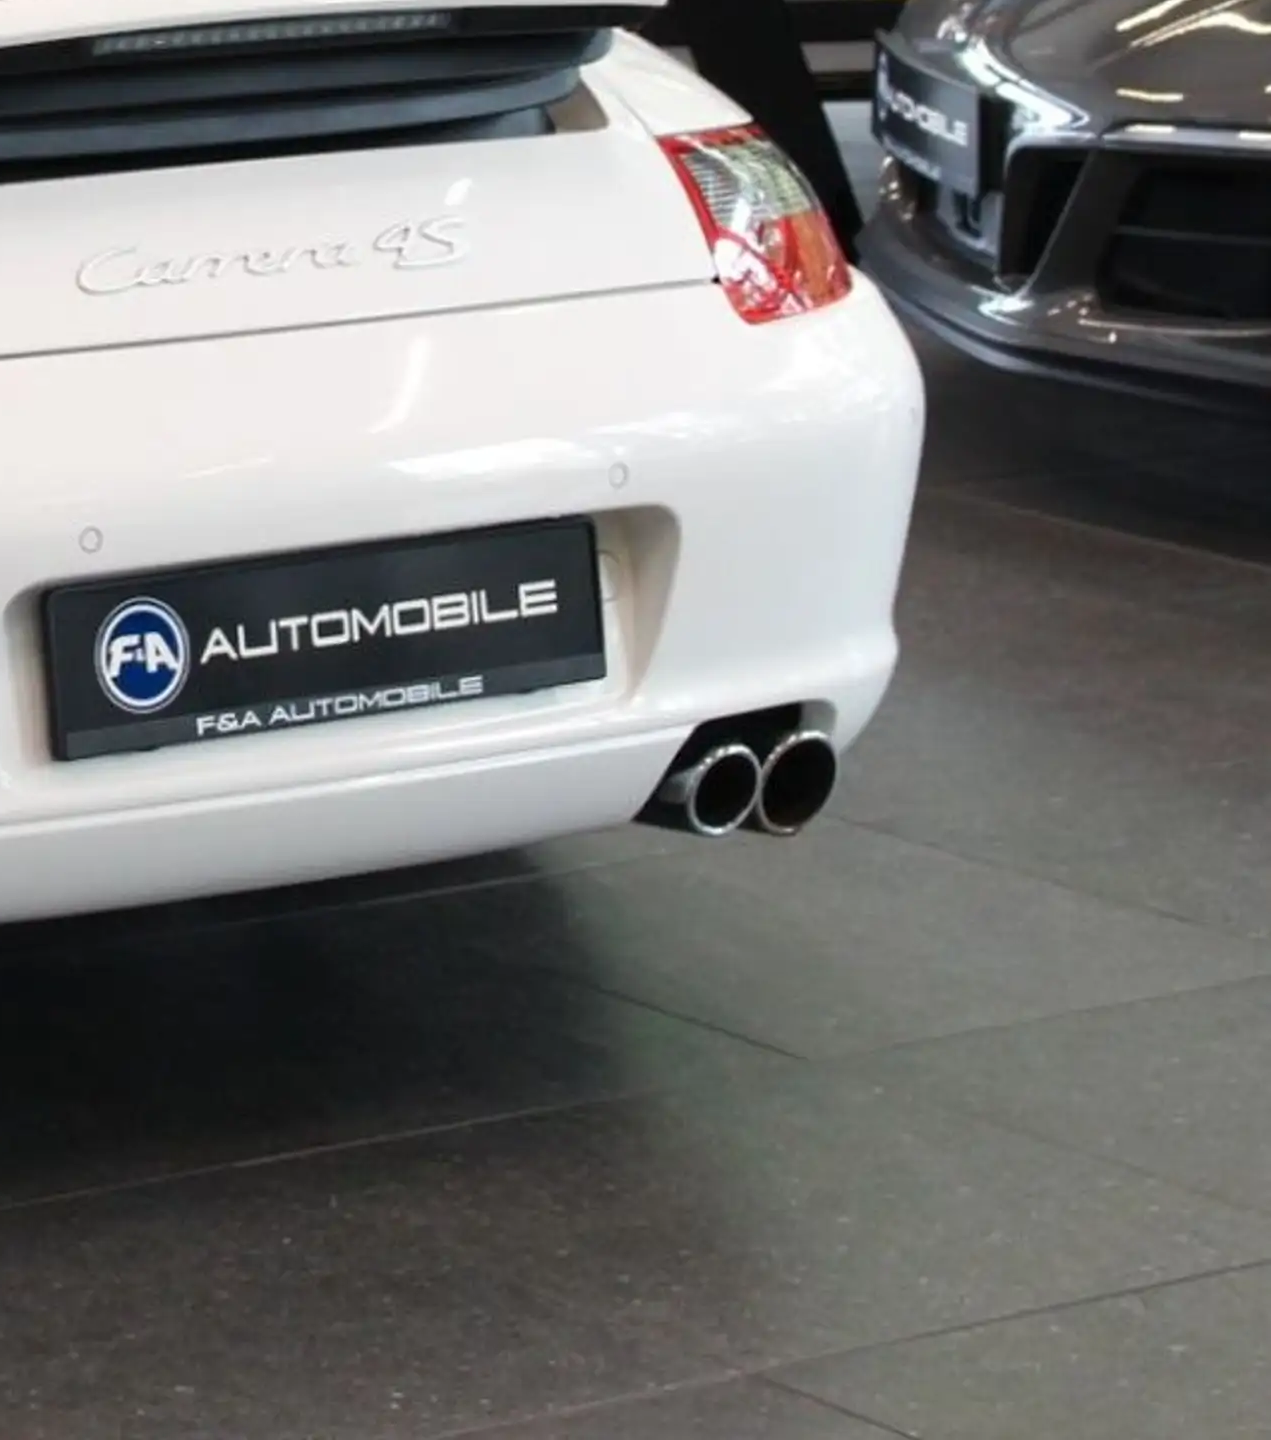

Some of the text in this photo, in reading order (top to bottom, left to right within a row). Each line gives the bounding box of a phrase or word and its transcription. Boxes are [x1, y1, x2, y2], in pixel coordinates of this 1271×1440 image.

[76, 215, 472, 295] Carrera 4S
[200, 579, 558, 664] AUTOMOBILE
[195, 675, 484, 736] F&A AUTOMOBILE
